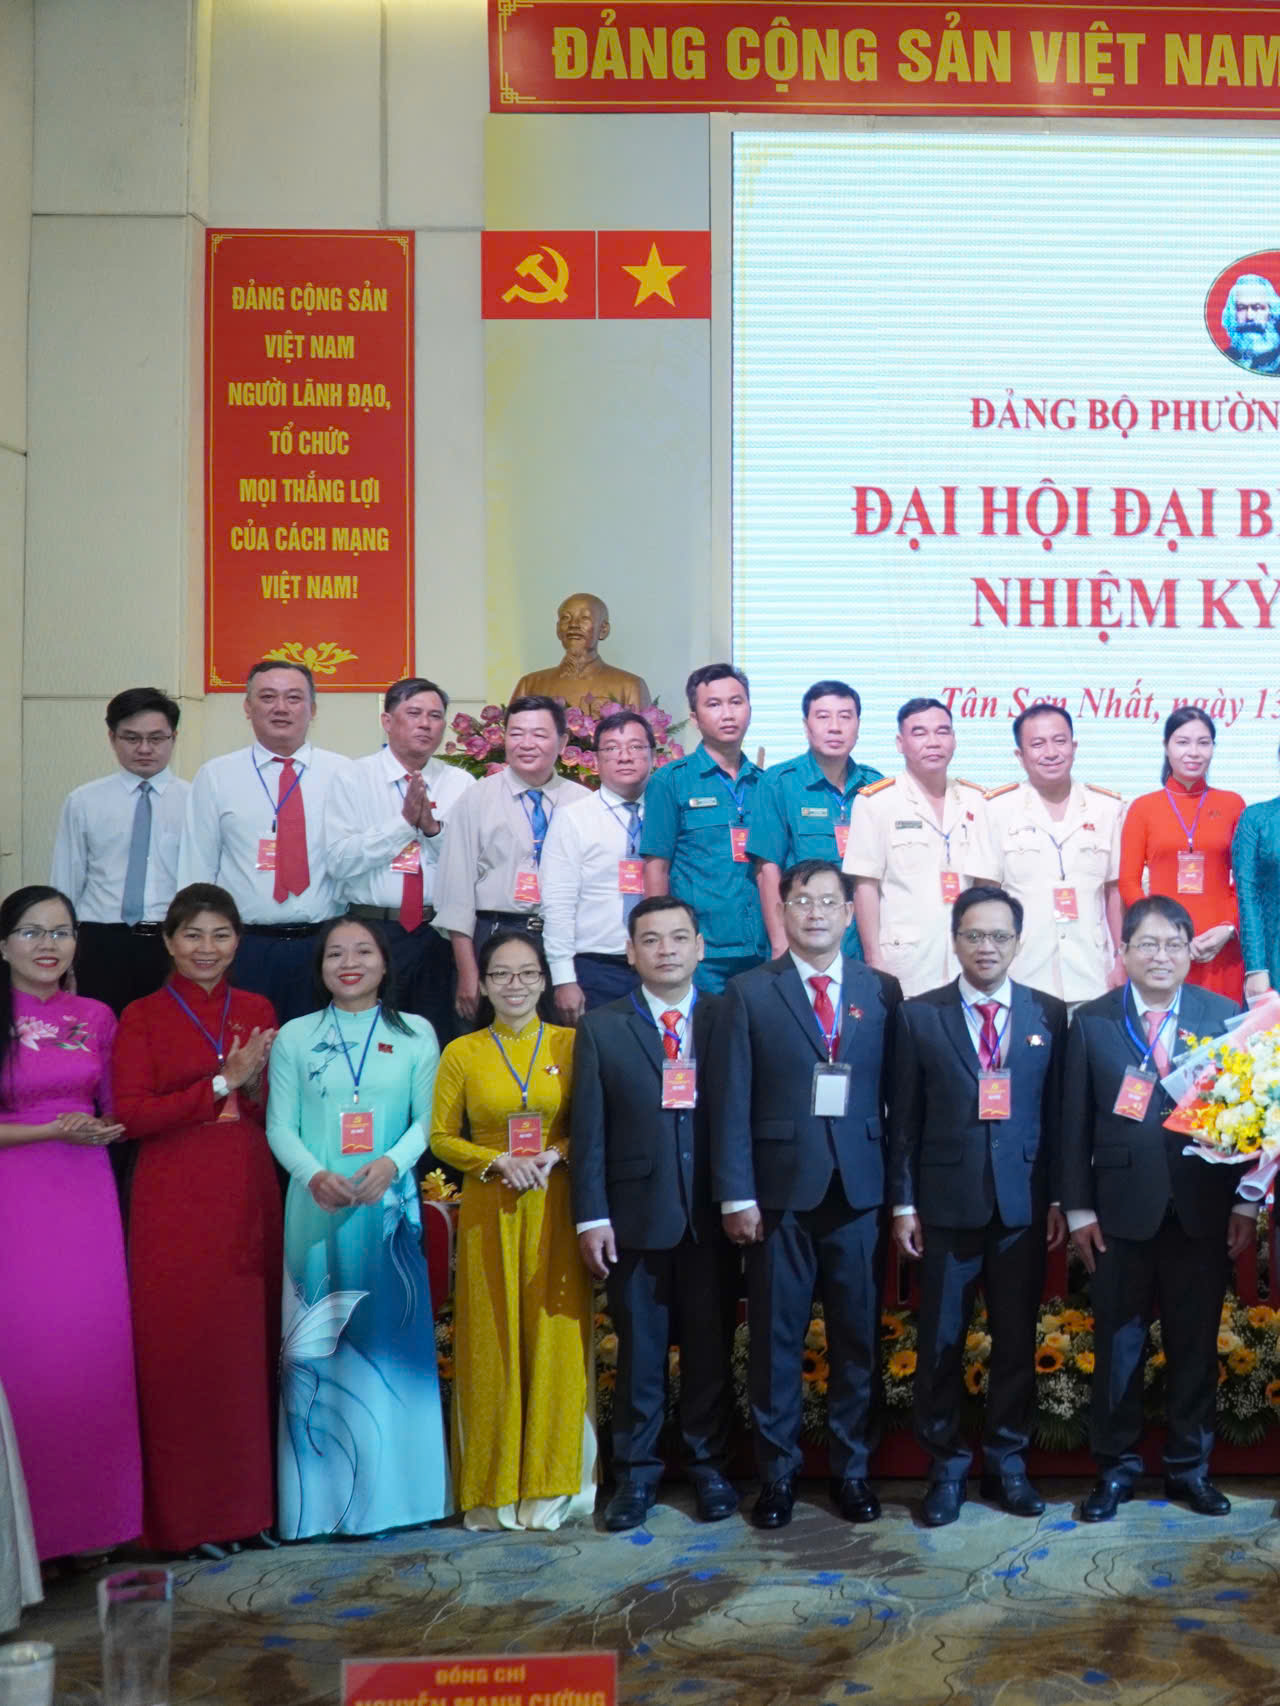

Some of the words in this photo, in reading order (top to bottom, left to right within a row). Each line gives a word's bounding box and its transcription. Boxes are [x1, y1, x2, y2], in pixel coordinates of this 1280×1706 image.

[552, 9, 706, 80] ĐẢNG
[726, 17, 878, 92] CỘNG
[898, 11, 1012, 83] SẢN
[1035, 21, 1146, 96] VIỆT
[232, 279, 284, 310] ĐẢNG
[291, 283, 342, 316] CỘNG
[348, 280, 387, 312] SẢN
[265, 330, 304, 363] VIỆT
[310, 335, 355, 359] NAM
[228, 377, 287, 406] NGƯỜI
[293, 379, 342, 407] LÃNH
[347, 384, 391, 412] ĐẠO,
[970, 388, 1076, 429] ĐẢNG
[1088, 394, 1138, 439] BỘ
[269, 421, 294, 454] TỔ
[298, 426, 350, 455] CHỨC
[239, 479, 276, 507] MỌI
[282, 470, 345, 503] THẮNG
[351, 477, 380, 508] LỢI
[851, 486, 960, 551] ĐẠI
[978, 477, 1092, 551] HỘI
[1110, 487, 1217, 552] ĐẠI
[231, 519, 270, 551] CỦA
[275, 521, 326, 551] CÁCH
[332, 527, 389, 556] MẠNG
[261, 571, 302, 604] VIỆT
[307, 575, 359, 599] NAM!
[970, 569, 1180, 644] NHIỆM
[941, 687, 998, 718] Tân
[1077, 679, 1160, 724] Nhất,
